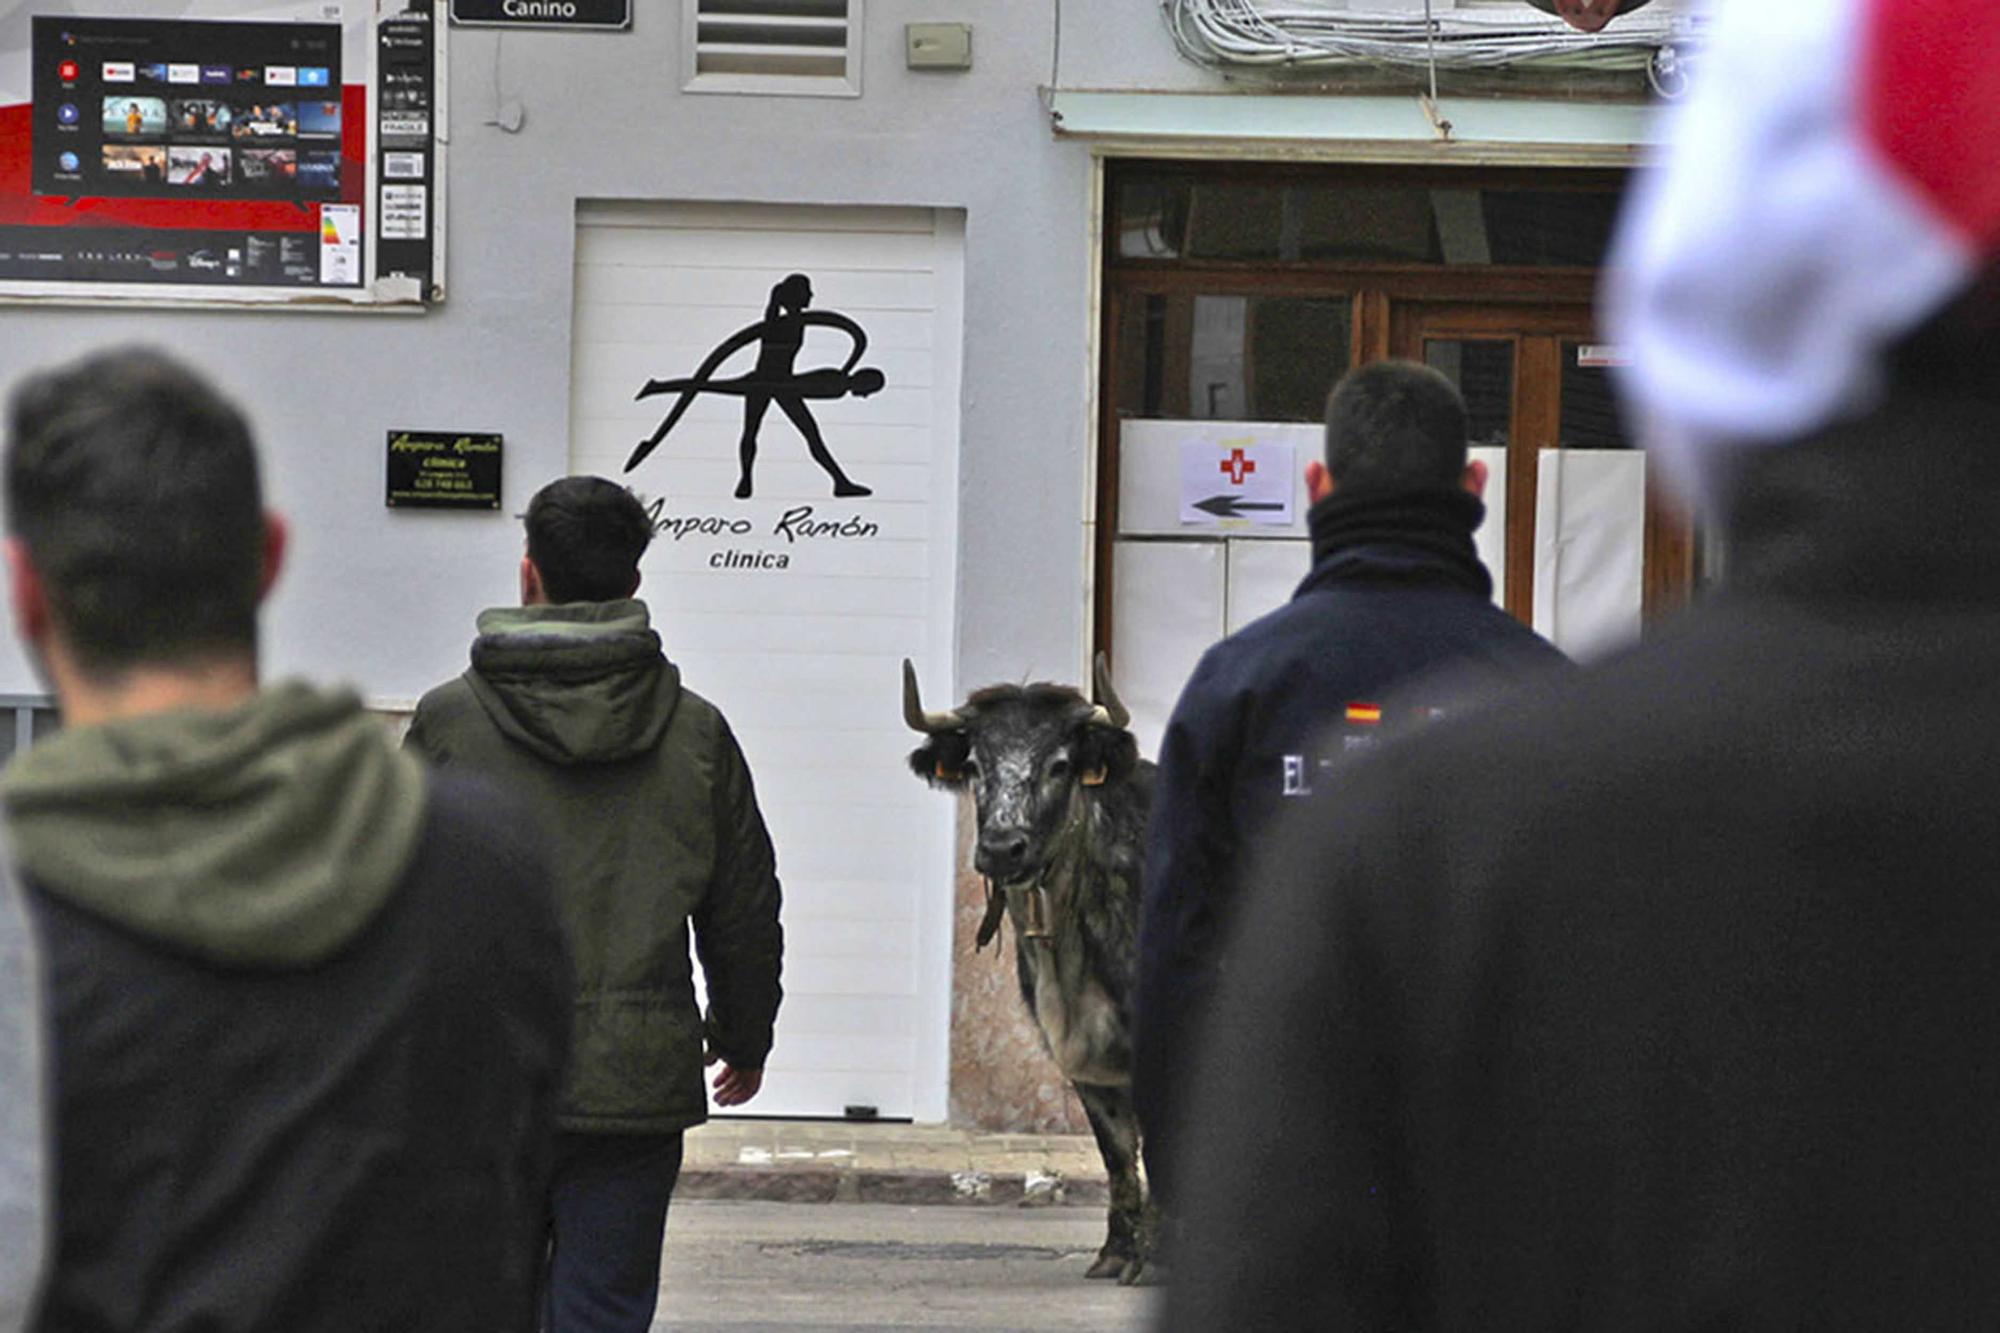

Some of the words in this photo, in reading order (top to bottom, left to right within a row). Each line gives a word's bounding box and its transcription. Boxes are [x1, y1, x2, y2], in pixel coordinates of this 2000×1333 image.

[503, 0, 576, 17] Canino
[649, 497, 752, 541] Amparo
[774, 506, 879, 543] Ramón
